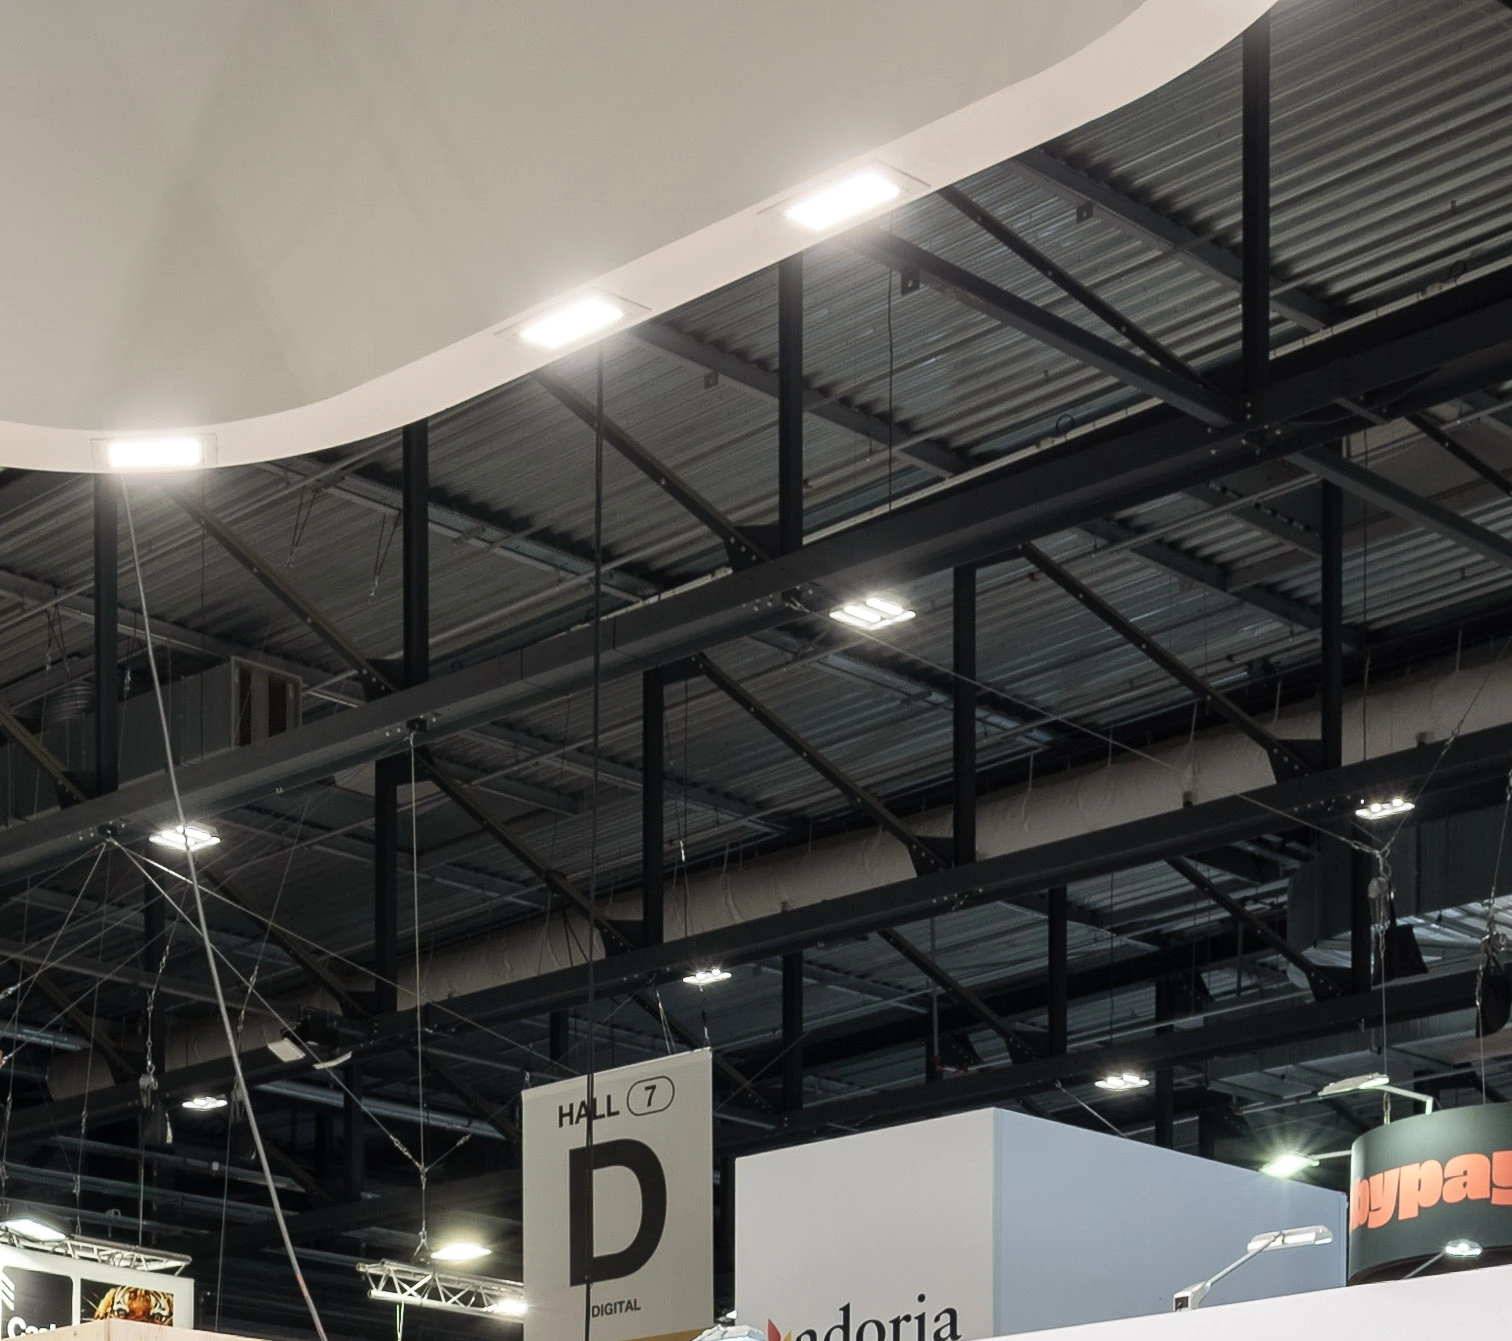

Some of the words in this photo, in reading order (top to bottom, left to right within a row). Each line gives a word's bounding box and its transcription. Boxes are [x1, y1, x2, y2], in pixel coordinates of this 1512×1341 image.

[558, 1093, 620, 1129] HALL
[644, 1084, 658, 1107] 7
[569, 1137, 668, 1288] D
[591, 1299, 641, 1320] DIGITAL
